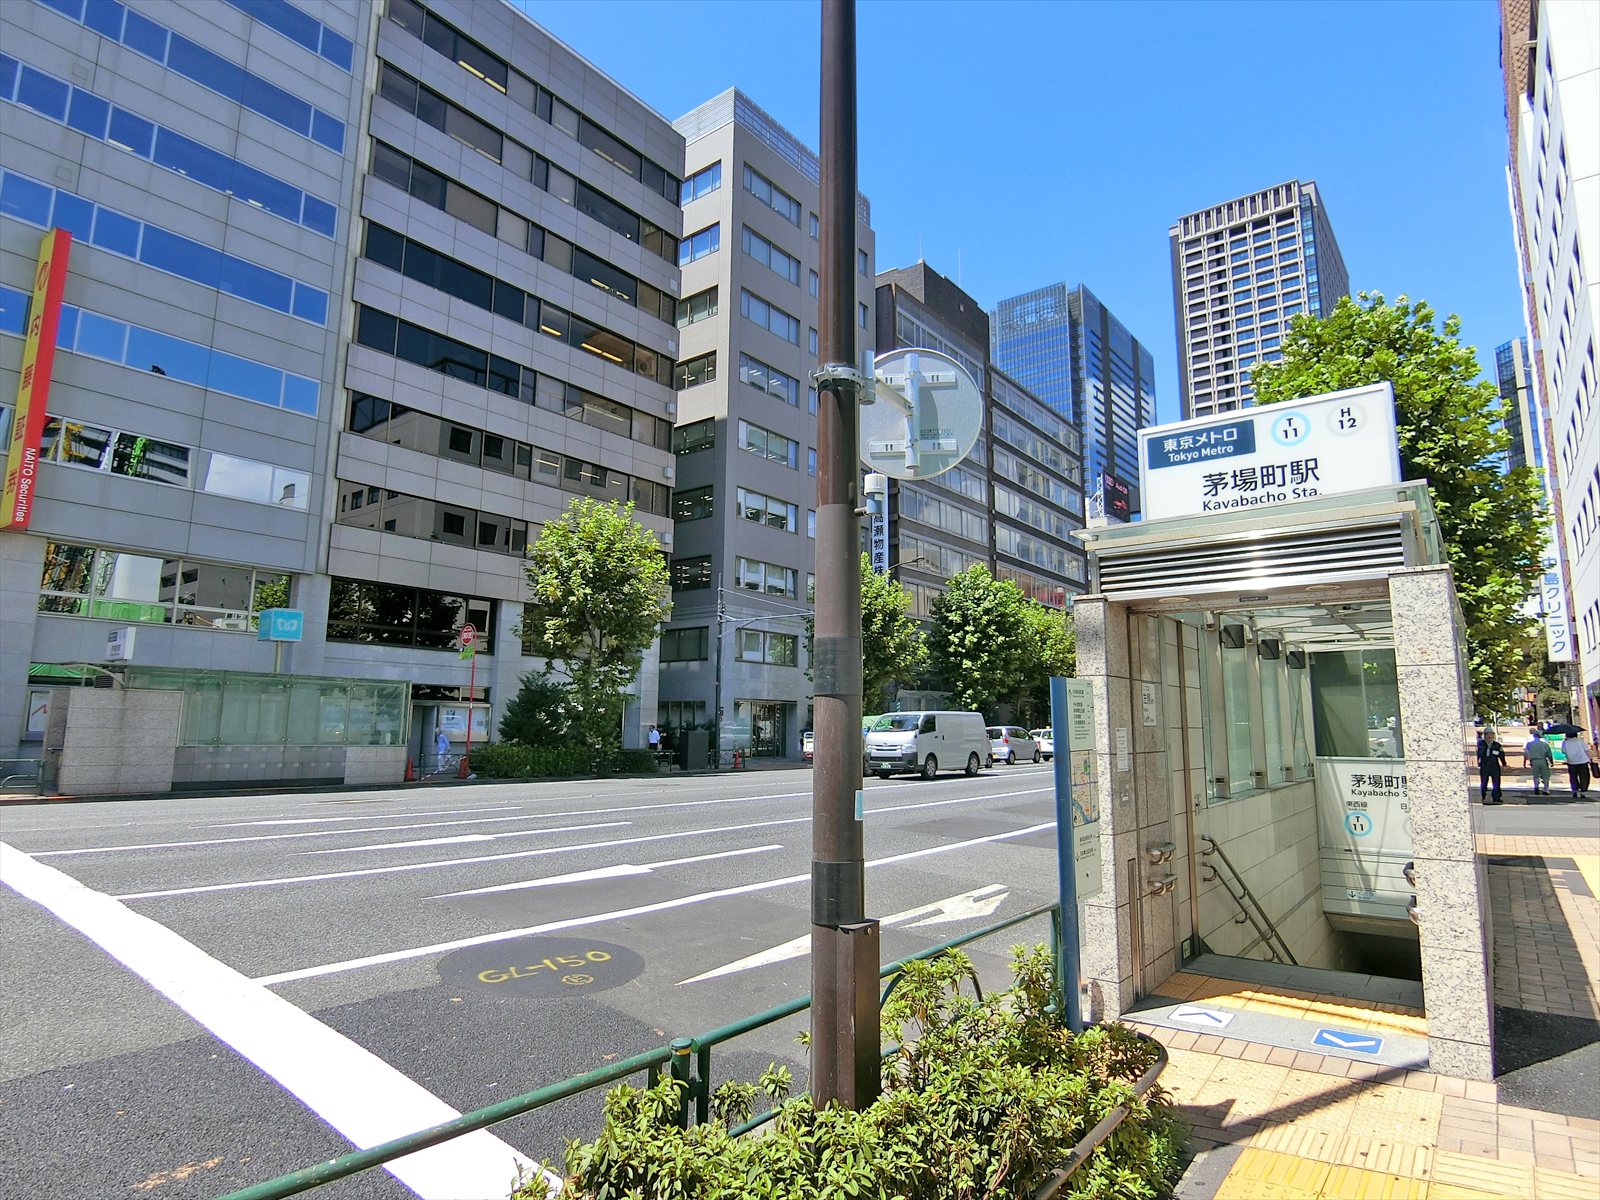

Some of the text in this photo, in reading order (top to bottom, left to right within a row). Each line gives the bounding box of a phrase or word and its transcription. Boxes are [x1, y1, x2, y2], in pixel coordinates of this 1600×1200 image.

[1340, 407, 1351, 418] H
[1286, 418, 1294, 427] T
[1338, 418, 1357, 430] 12
[1283, 428, 1298, 439] 11
[1163, 428, 1237, 452] 東京メトロ
[1168, 445, 1234, 463] Tokyo Metro
[1202, 457, 1320, 497] 茅場町駅
[15, 447, 37, 523] NAITO Securities
[1292, 487, 1322, 499] Sta.
[1542, 557, 1566, 654] 中島クリニック
[1351, 789, 1400, 798] Kayabacho
[1353, 823, 1364, 831] 11
[477, 950, 611, 983] GL-150
